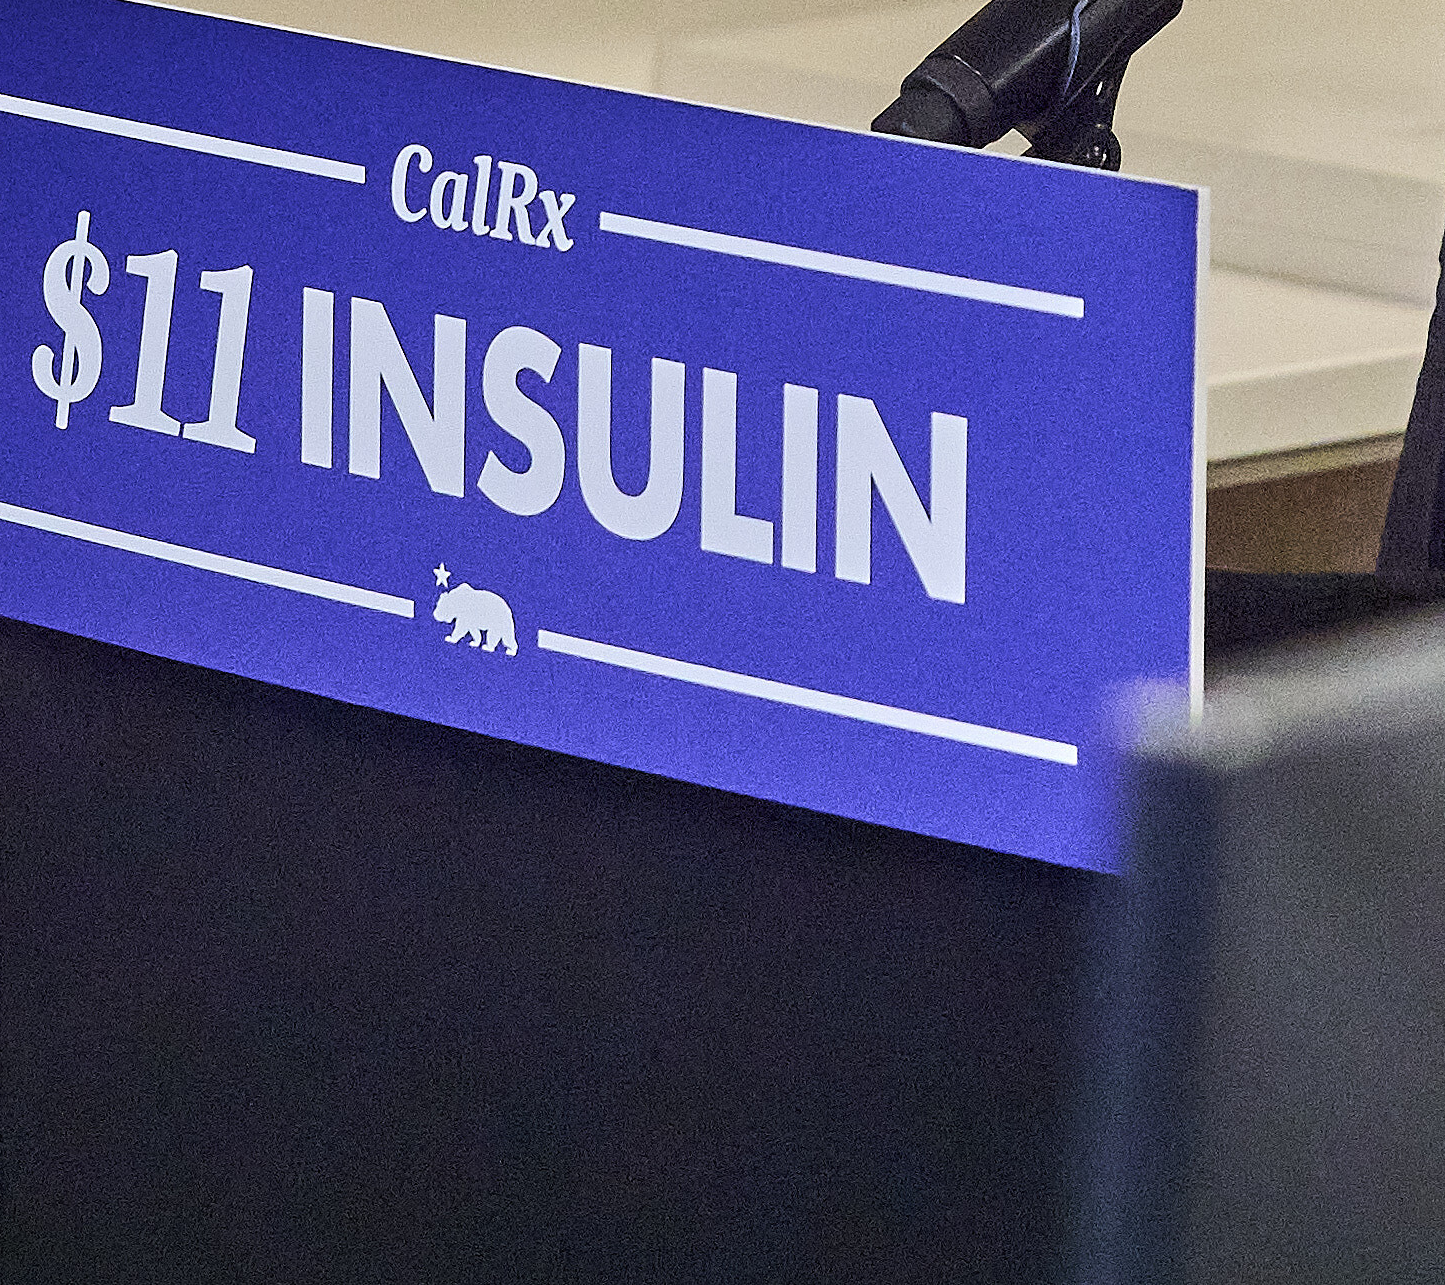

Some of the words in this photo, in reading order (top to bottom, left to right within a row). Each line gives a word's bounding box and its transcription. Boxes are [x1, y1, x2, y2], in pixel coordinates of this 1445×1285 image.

[391, 144, 576, 253] CalRx
[31, 210, 258, 455] $11
[300, 286, 969, 605] INSULIN
